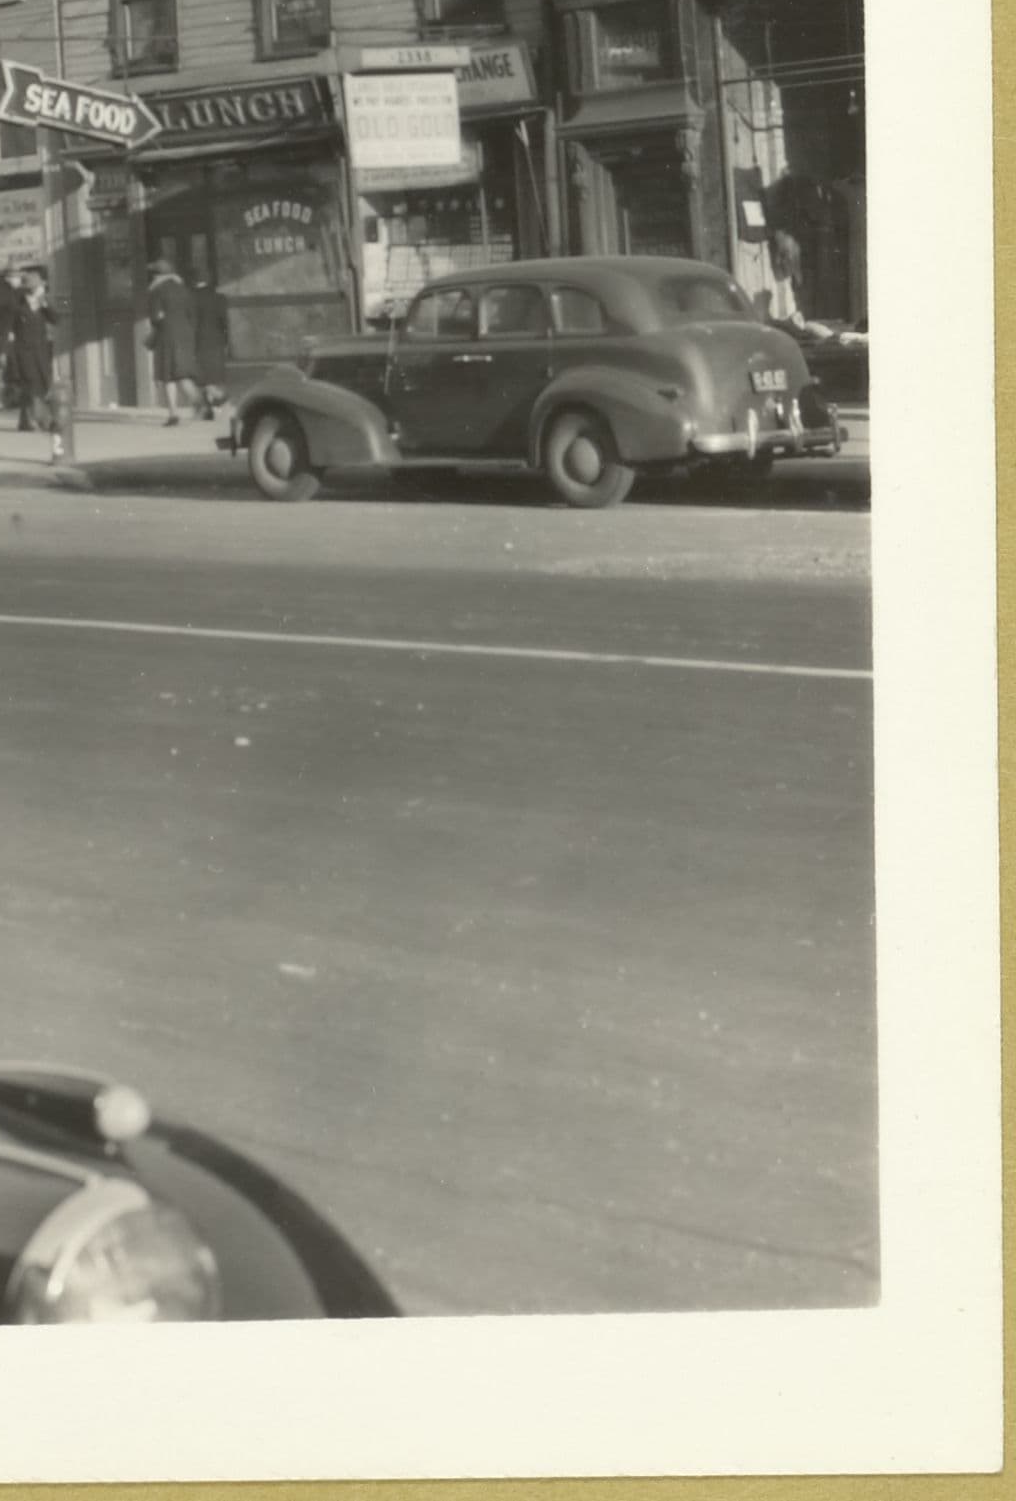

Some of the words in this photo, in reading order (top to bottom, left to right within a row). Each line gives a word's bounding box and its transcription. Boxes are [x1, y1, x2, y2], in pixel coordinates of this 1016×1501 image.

[24, 83, 72, 121] SEA
[75, 95, 136, 135] FOOD
[156, 88, 306, 131] LUNCH
[357, 115, 399, 140] OLD
[408, 112, 456, 138] GOLD
[254, 235, 305, 255] LUNCH
